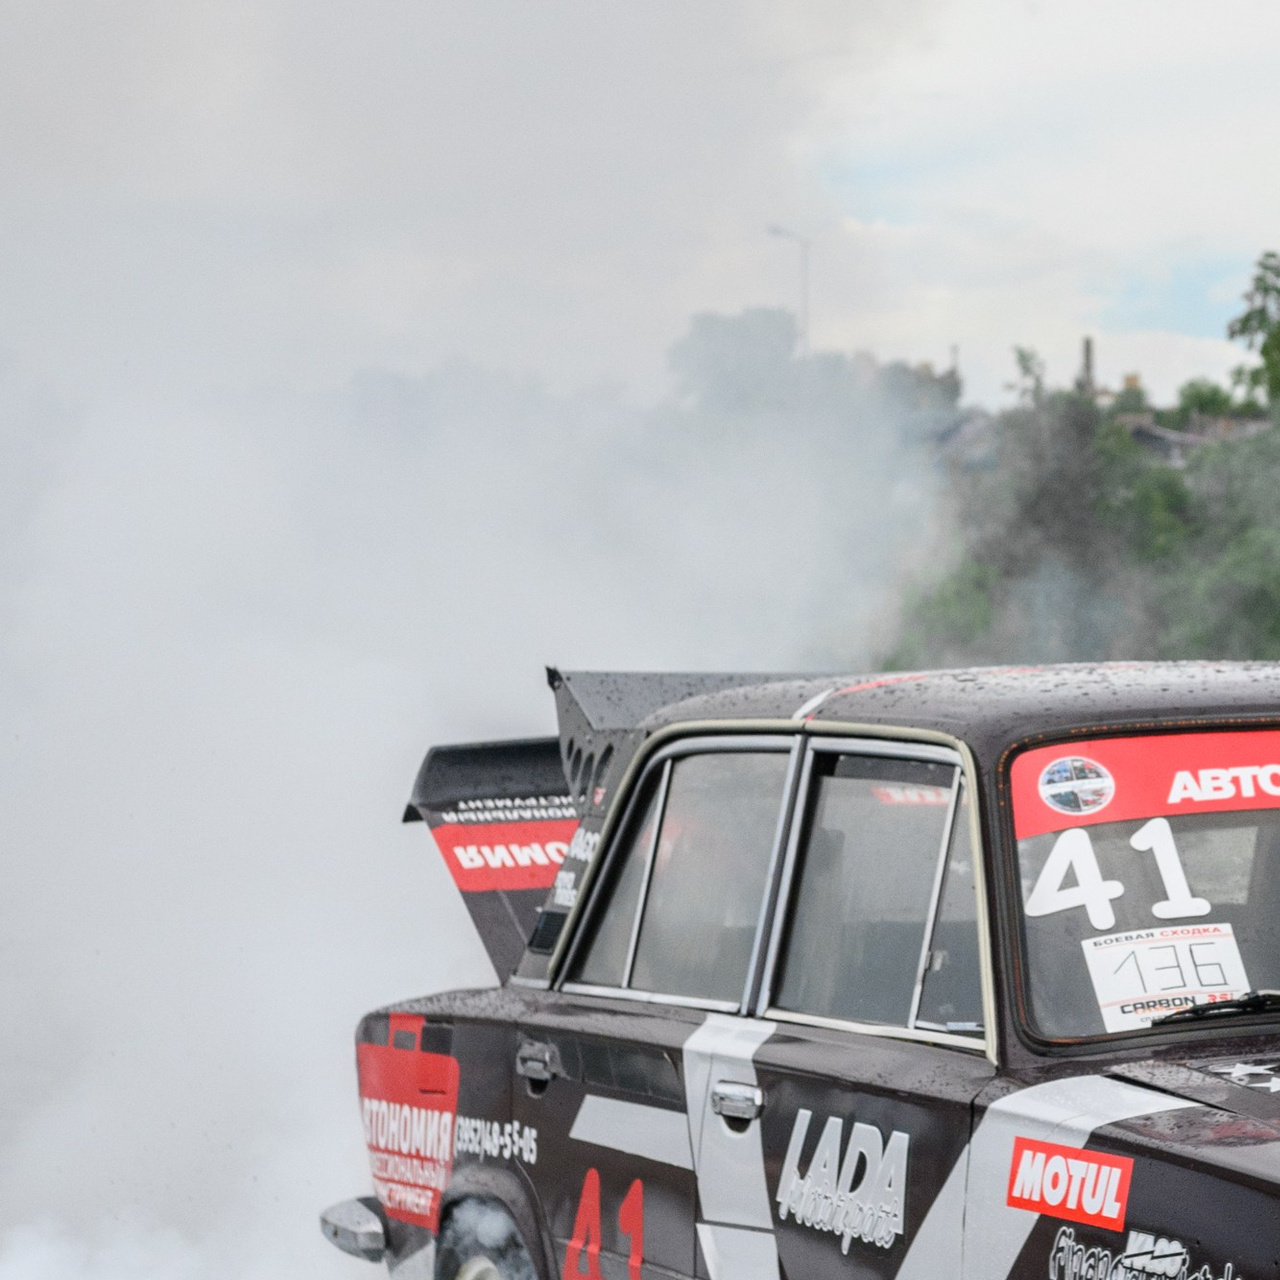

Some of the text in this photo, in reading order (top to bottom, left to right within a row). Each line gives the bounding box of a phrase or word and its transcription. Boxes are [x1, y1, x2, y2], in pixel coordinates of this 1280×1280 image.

[453, 841, 569, 870] ОМИЯ
[1024, 817, 1212, 930] 41
[1092, 925, 1222, 948] БОЕВАЯ СХОДКА
[1113, 941, 1230, 994] 136
[1119, 995, 1197, 1015] CARBON
[776, 1108, 910, 1235] LADA
[1011, 1149, 1122, 1219] MOTUL
